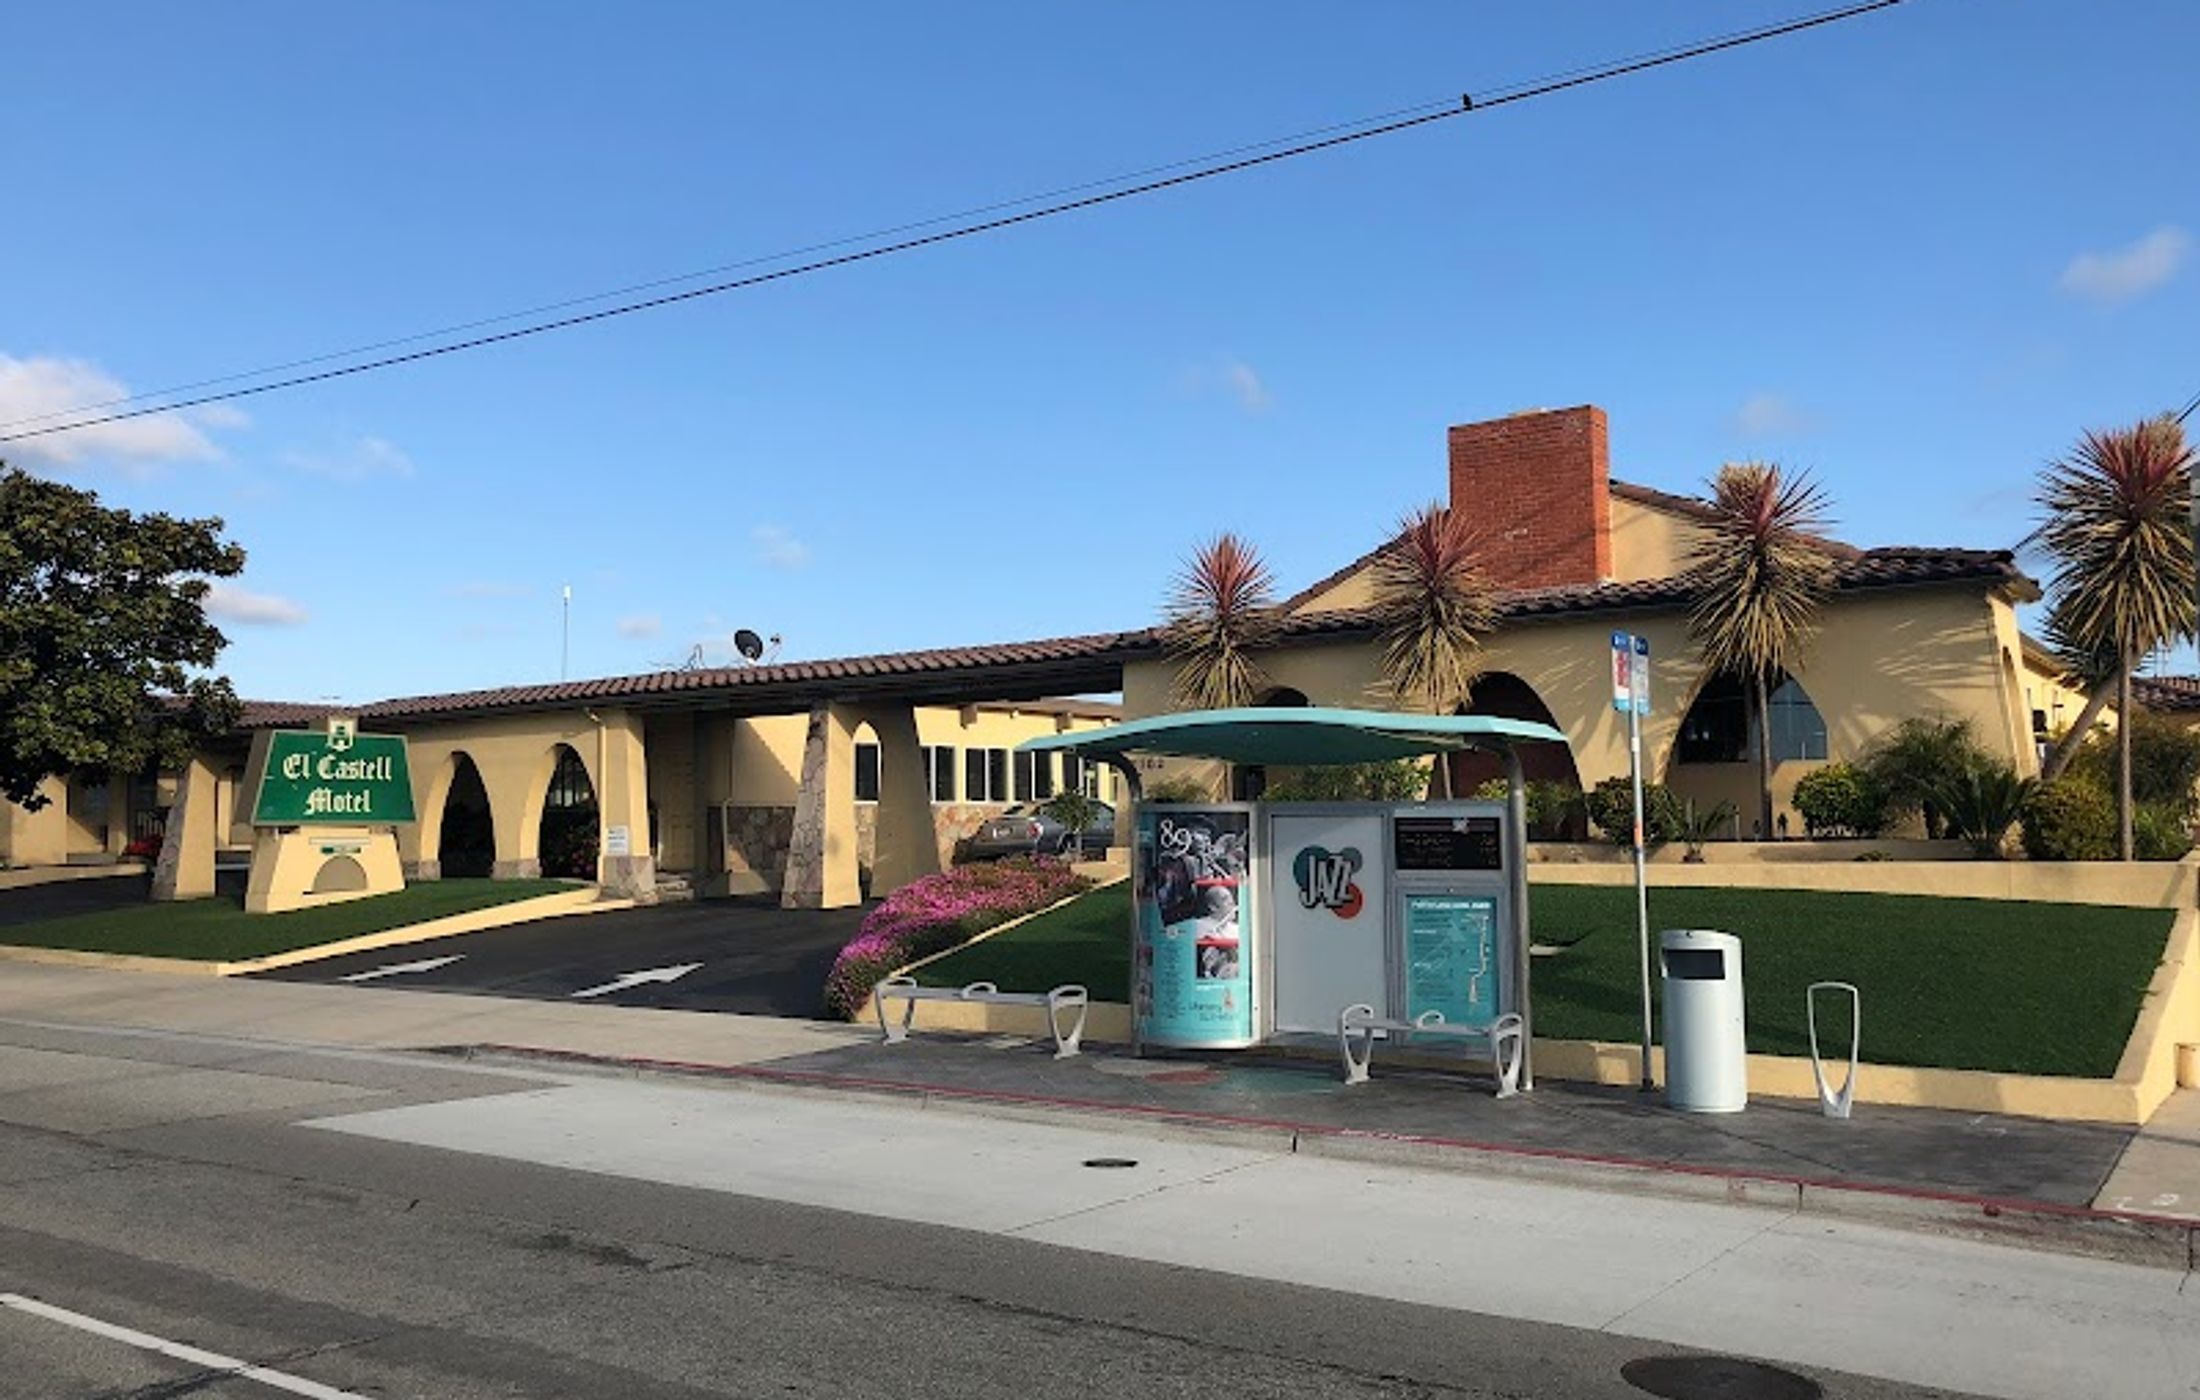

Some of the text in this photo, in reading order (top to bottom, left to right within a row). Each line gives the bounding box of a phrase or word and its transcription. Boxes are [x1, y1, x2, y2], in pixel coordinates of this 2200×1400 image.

[282, 753, 392, 781] El Castell
[304, 787, 371, 815] Motel
[1299, 852, 1354, 909] JAZZ
